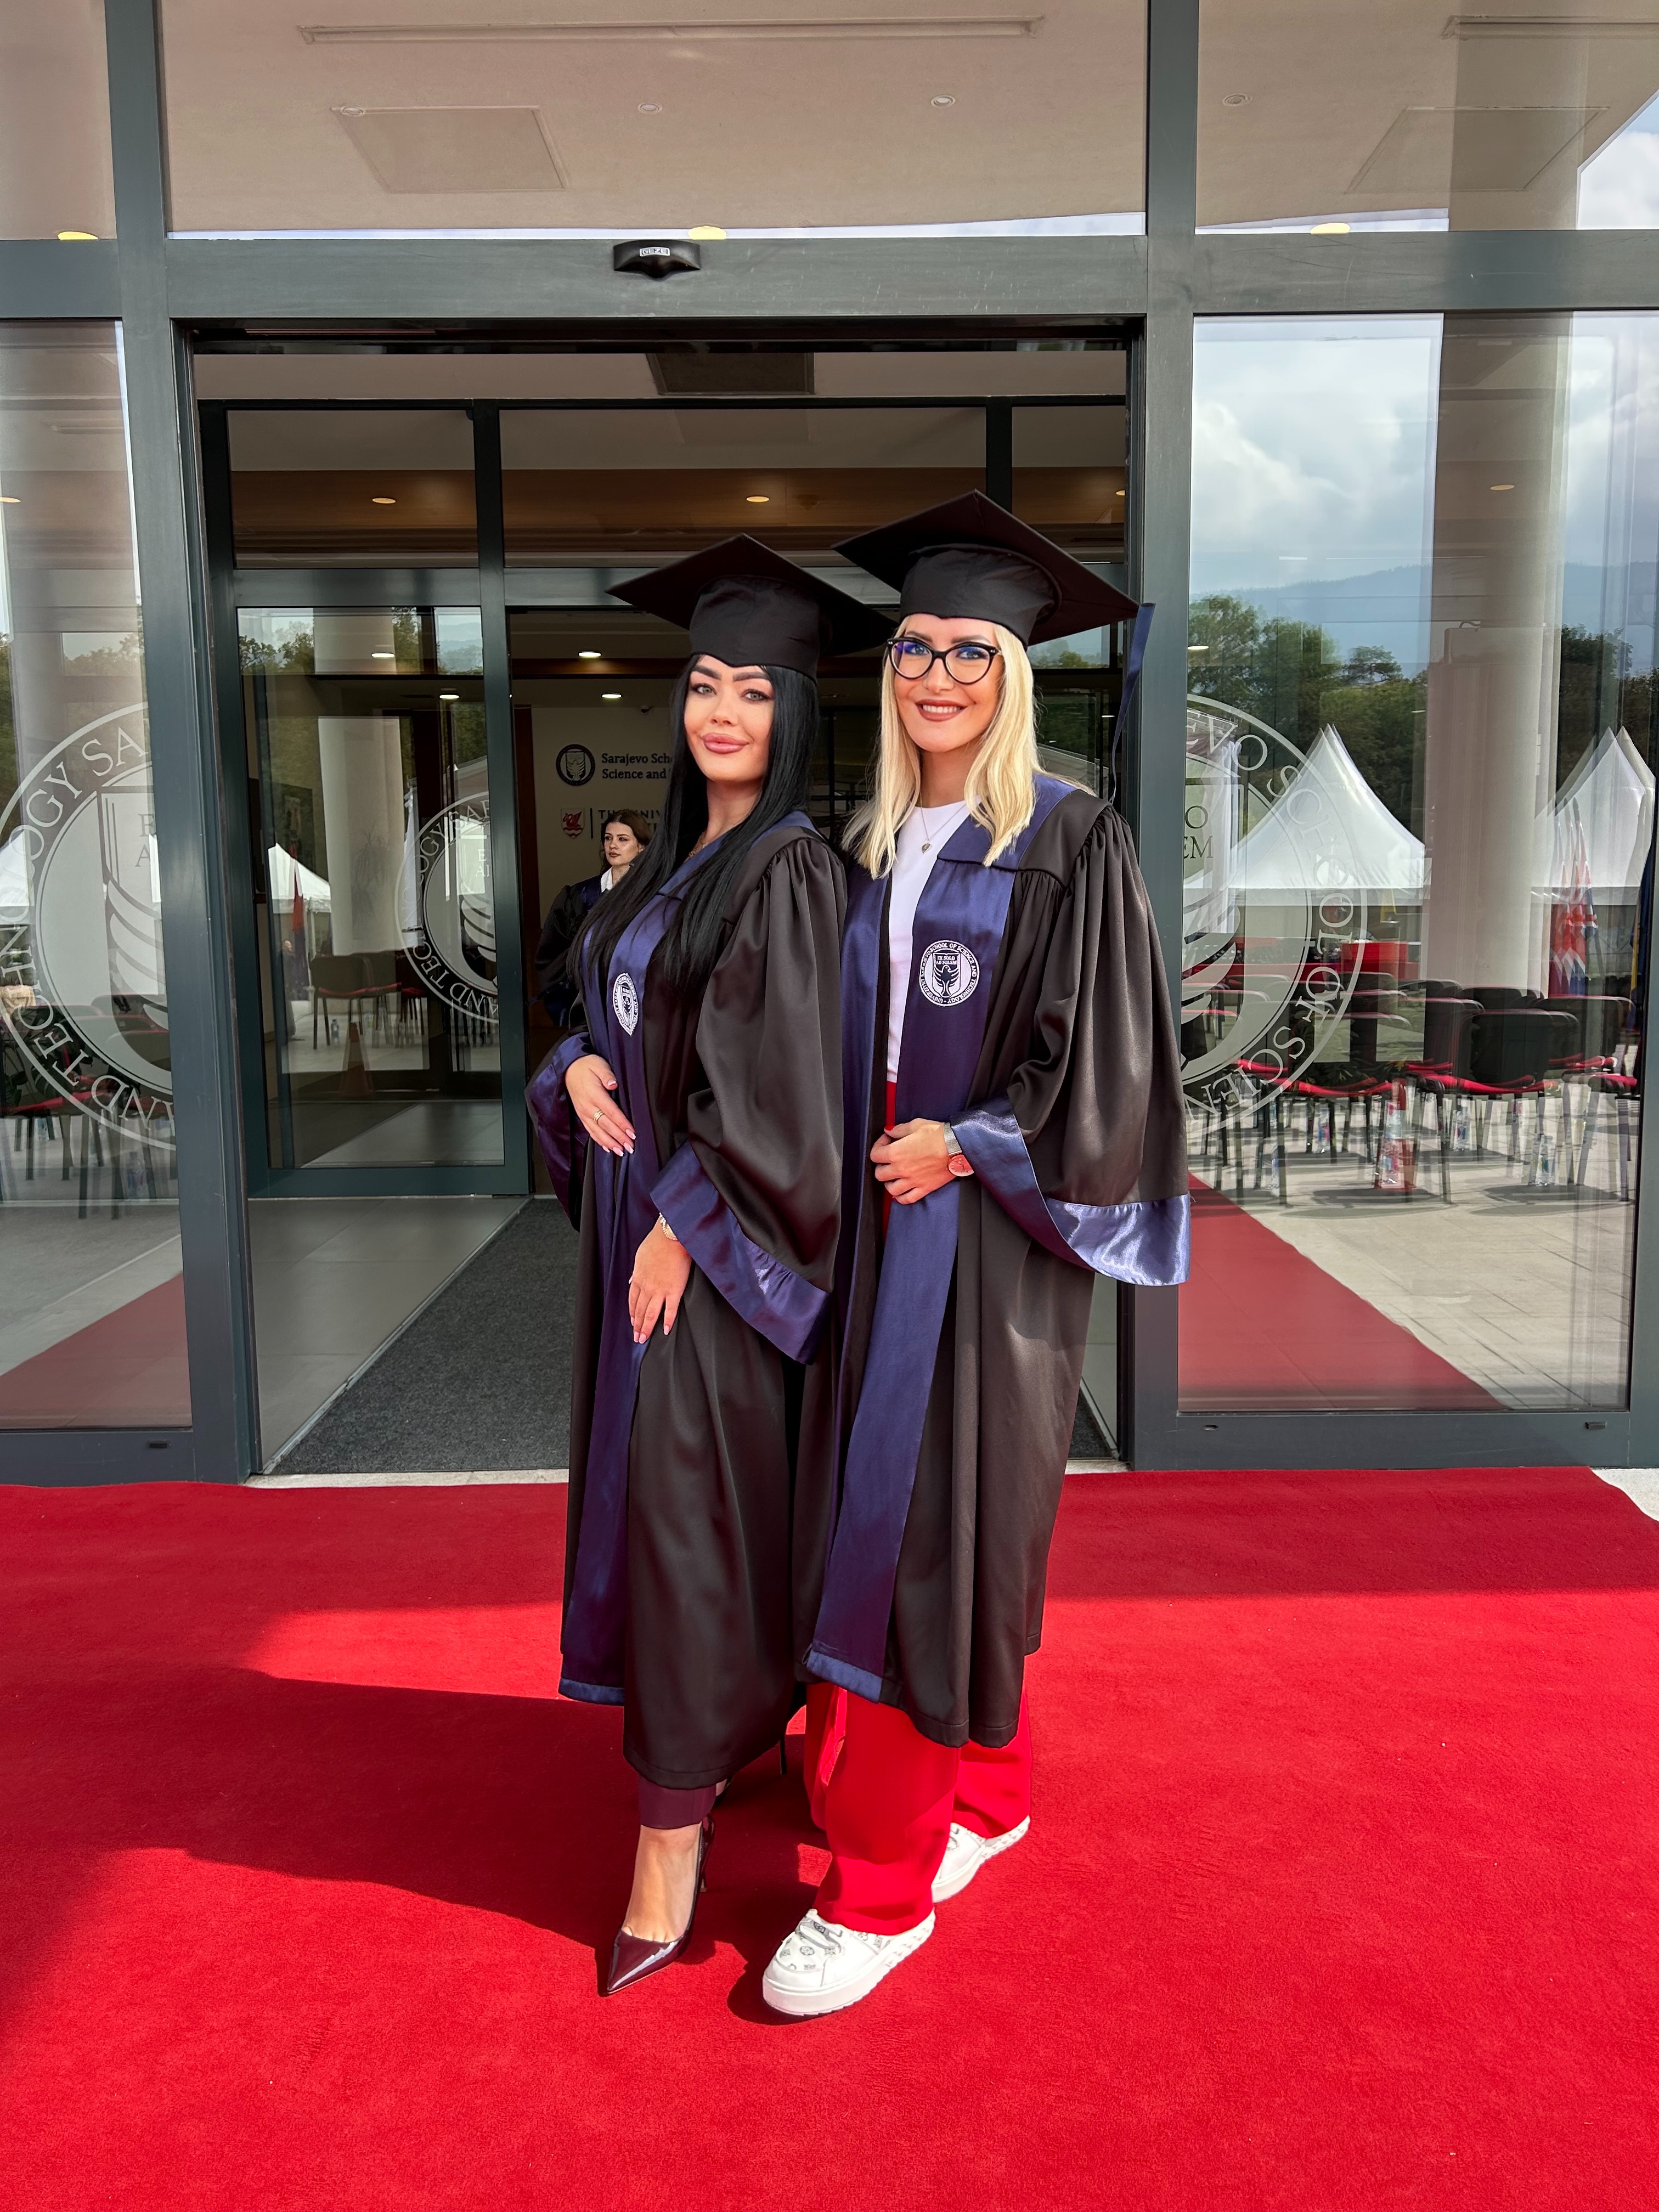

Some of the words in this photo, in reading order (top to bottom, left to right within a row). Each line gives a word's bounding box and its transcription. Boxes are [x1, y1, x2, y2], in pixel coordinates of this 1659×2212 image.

[602, 753, 648, 766] Sarajevo
[602, 769, 643, 778] Science
[646, 769, 667, 778] and
[1267, 765, 1354, 955] SCHOOL
[929, 943, 948, 952] SCHOOL
[957, 946, 974, 964] SCIENCE
[947, 978, 977, 1004] TECHNOLOGY
[1295, 966, 1341, 1026] OF
